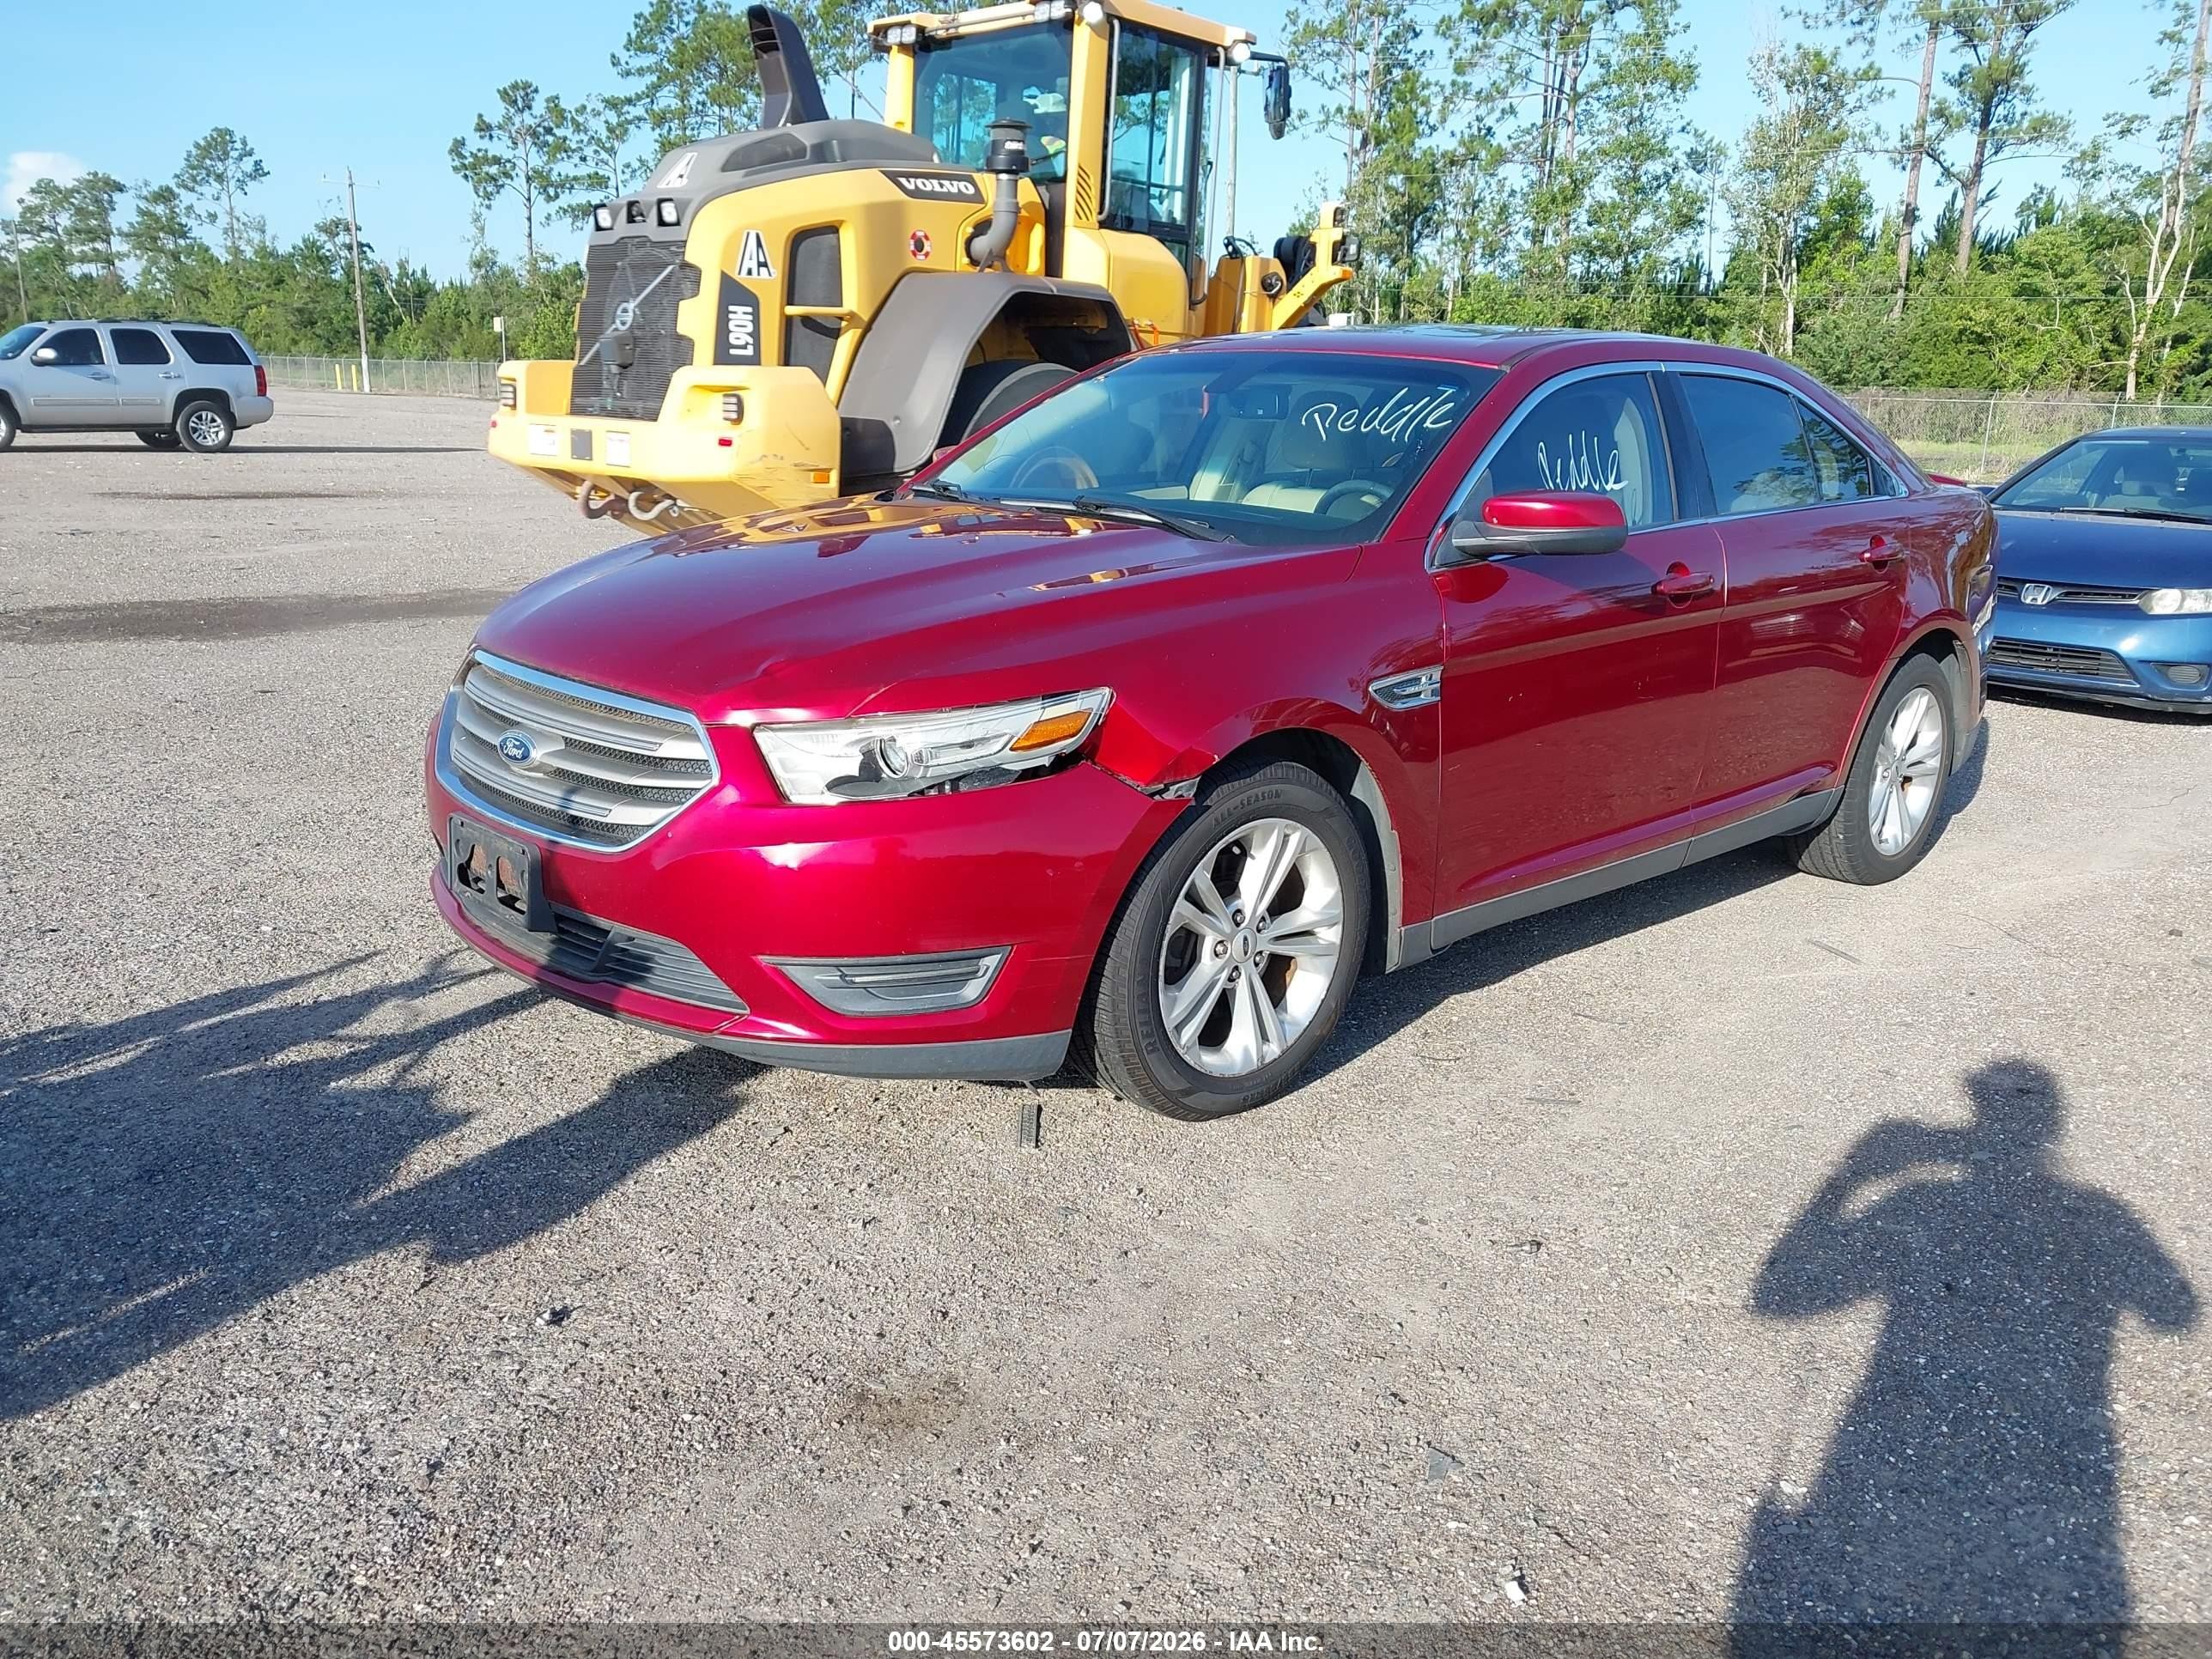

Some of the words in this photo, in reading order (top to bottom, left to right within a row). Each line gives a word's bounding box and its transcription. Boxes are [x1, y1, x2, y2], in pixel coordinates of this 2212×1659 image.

[896, 177, 975, 195] VOLVO
[727, 305, 755, 356] L90H
[1537, 429, 1629, 491] Peddle
[502, 738, 526, 759] Ford
[1210, 788, 1283, 830] ALL-SEASON
